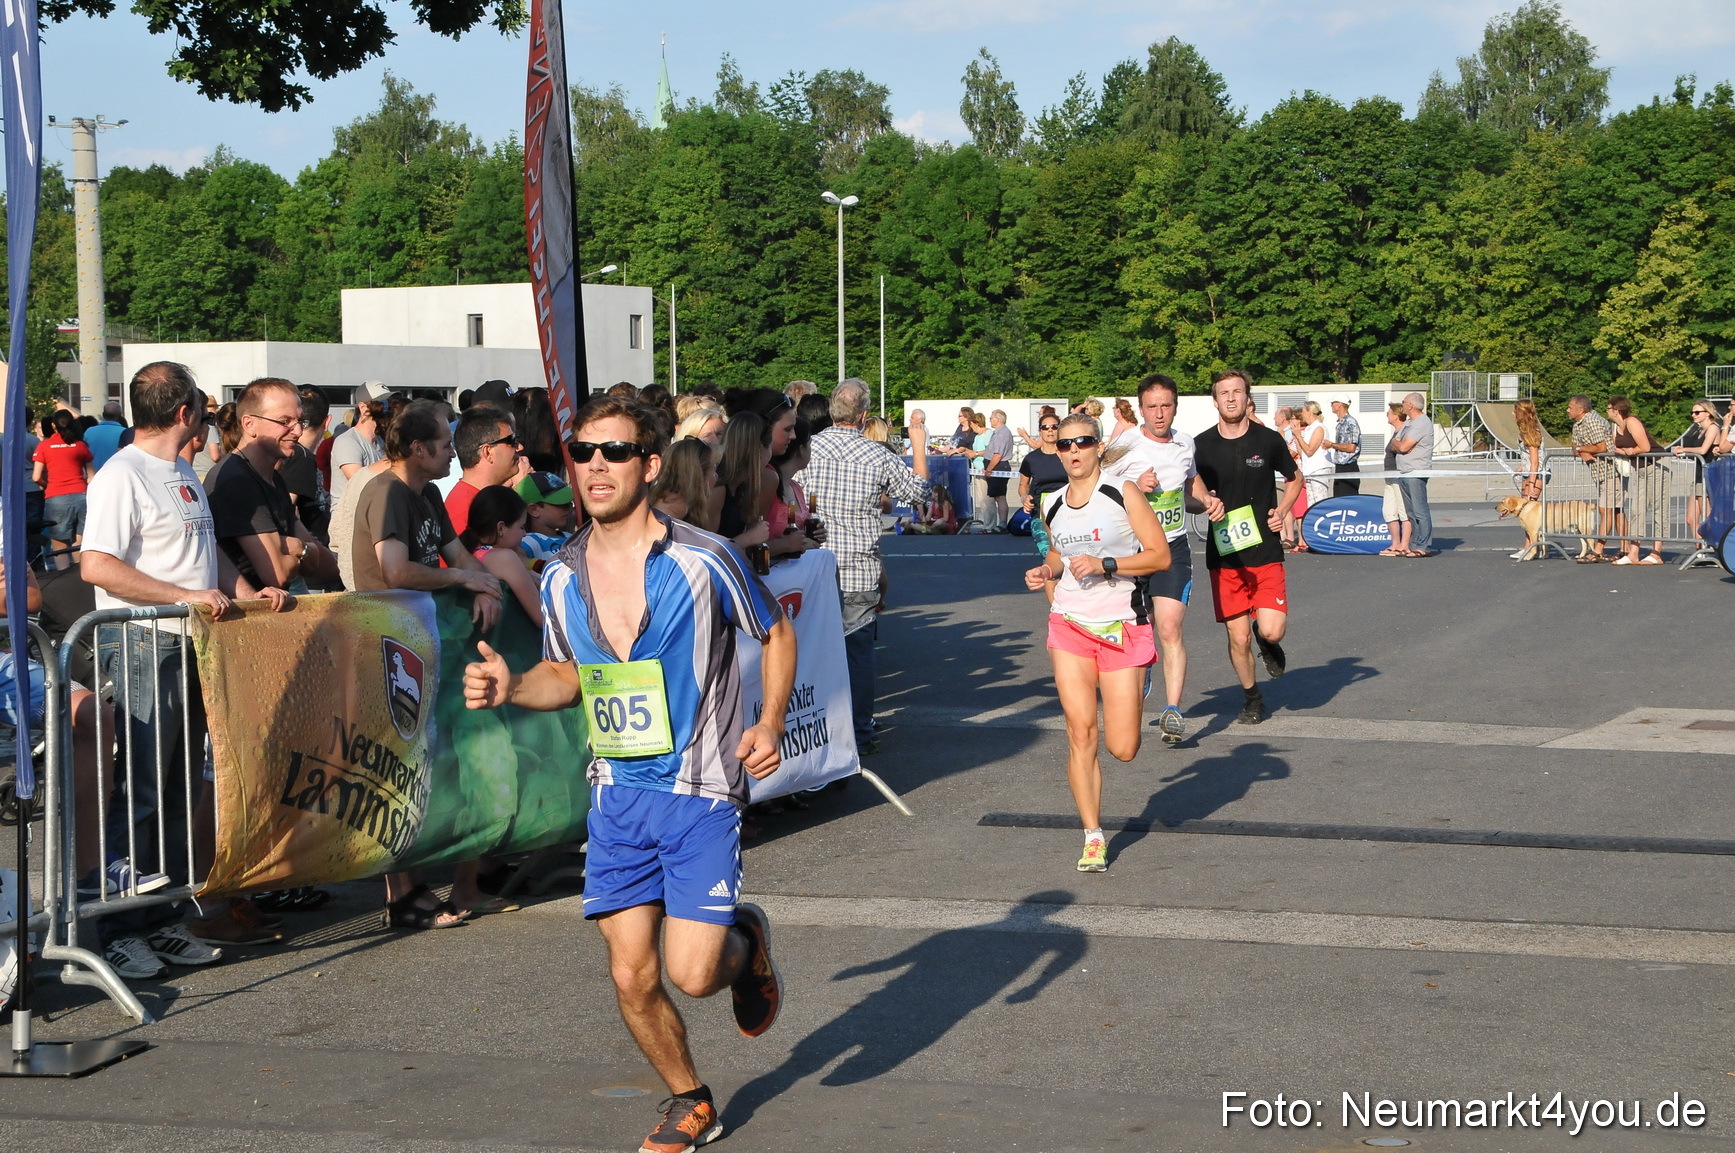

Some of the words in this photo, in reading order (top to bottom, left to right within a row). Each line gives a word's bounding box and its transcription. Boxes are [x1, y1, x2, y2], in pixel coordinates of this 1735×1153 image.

[1053, 528, 1101, 548] Xplus1
[1219, 521, 1252, 544] 318
[1329, 521, 1389, 535] Fische
[594, 694, 652, 733] 605
